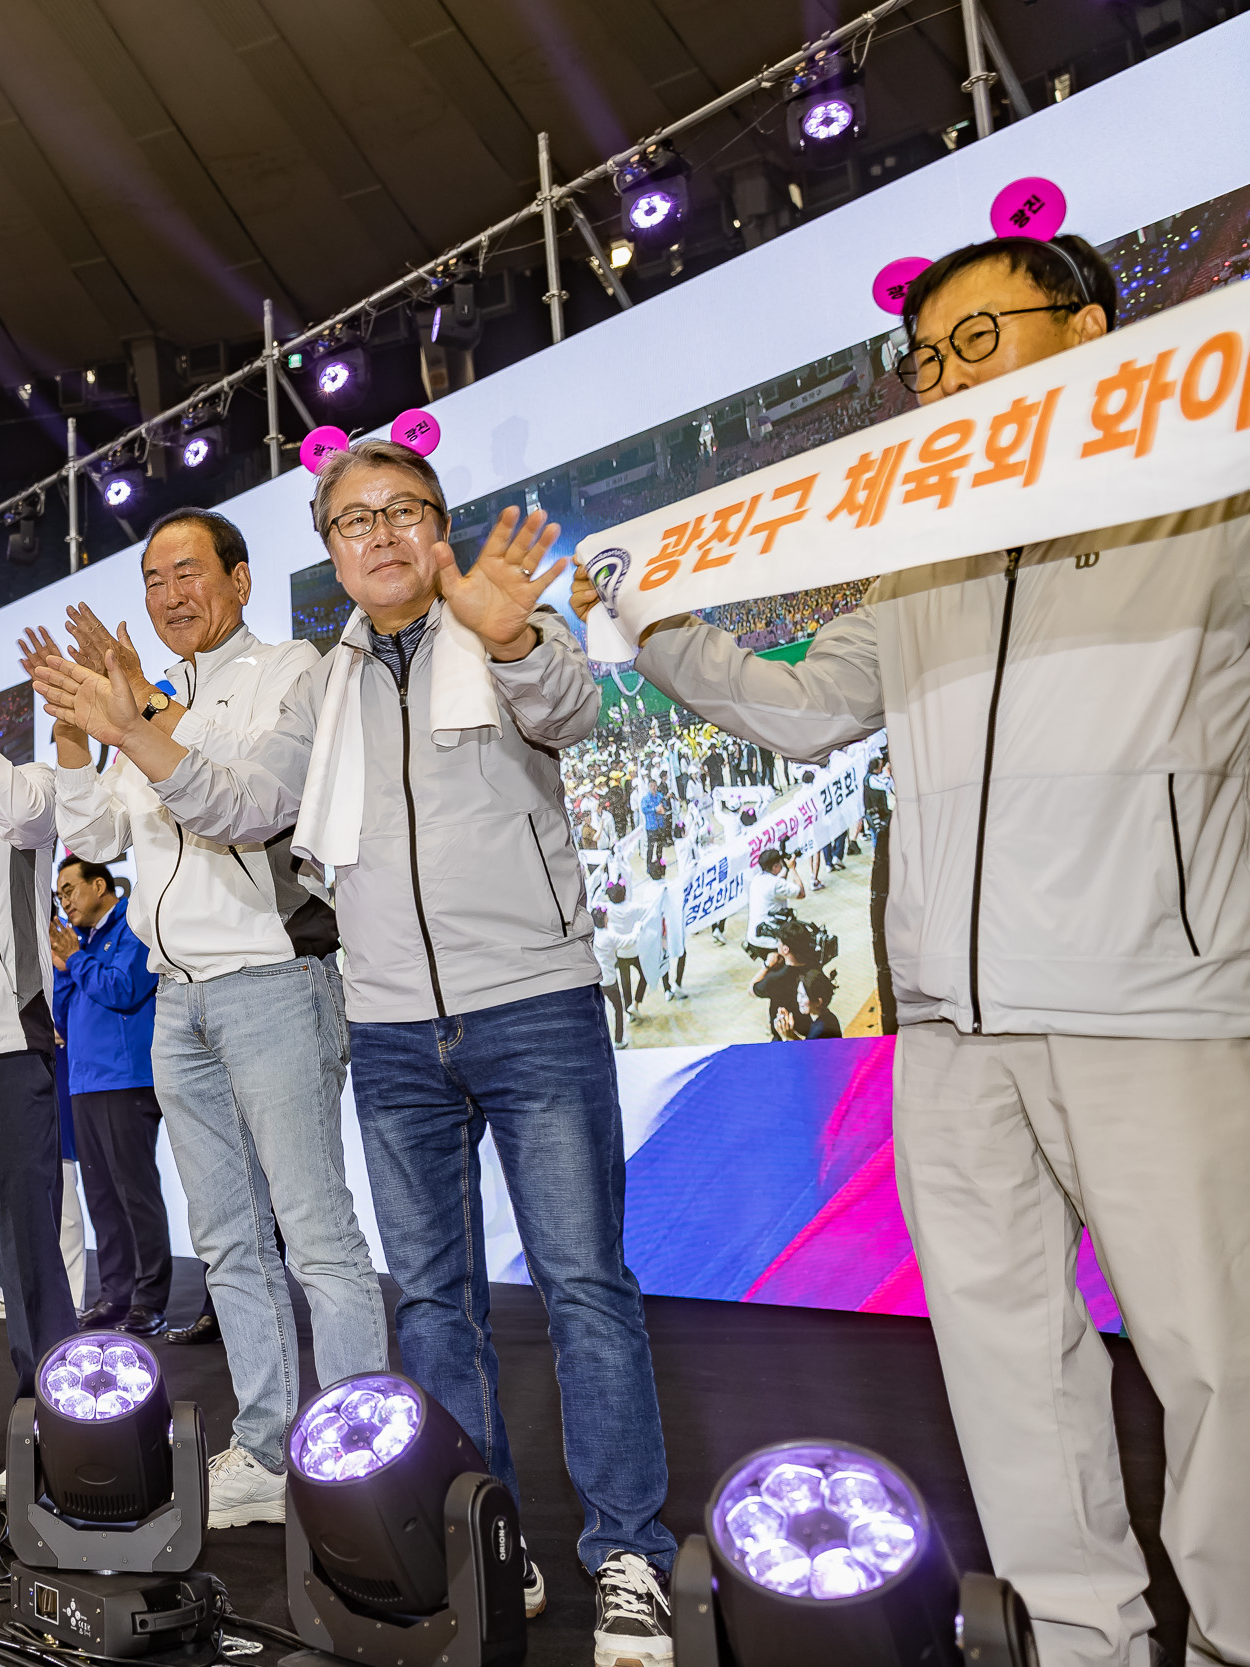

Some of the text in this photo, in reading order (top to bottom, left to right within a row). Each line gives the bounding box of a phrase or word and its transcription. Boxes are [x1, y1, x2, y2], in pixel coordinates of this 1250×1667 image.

[1009, 193, 1046, 229] 광진
[404, 420, 431, 442] 광진
[639, 472, 821, 591] 광진구
[826, 385, 1066, 529] 체육회
[497, 1520, 506, 1561] ORION-6
